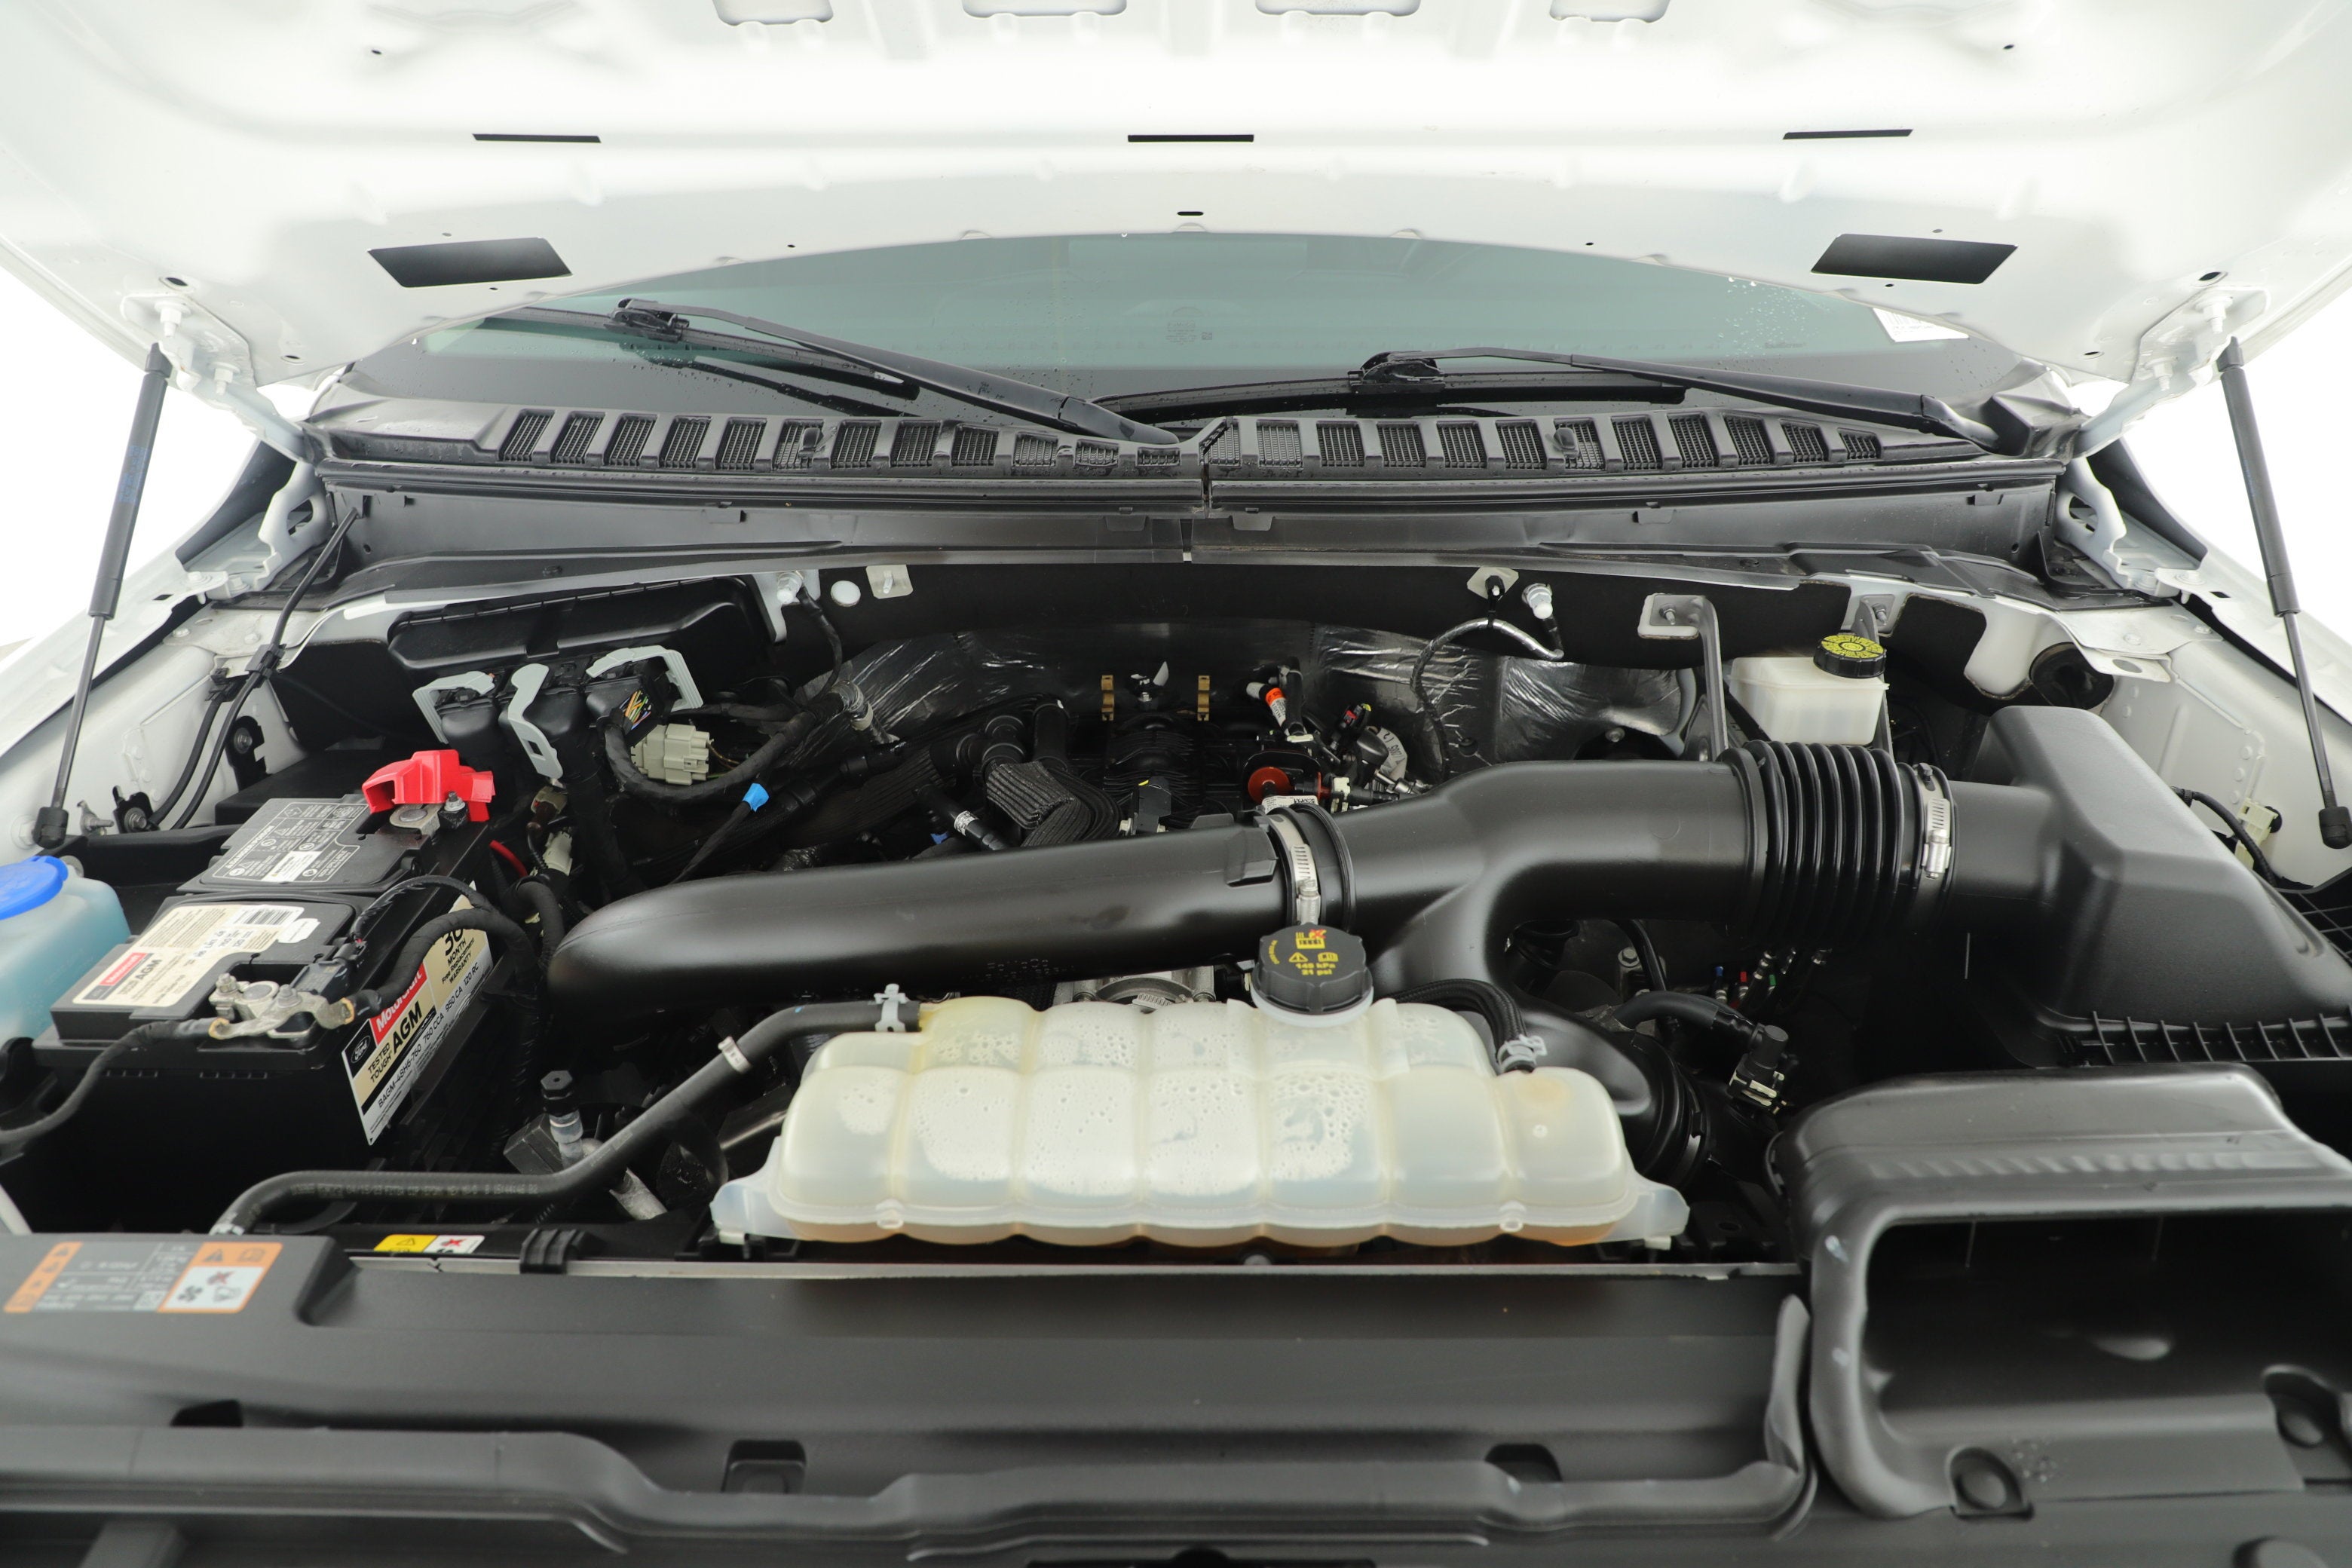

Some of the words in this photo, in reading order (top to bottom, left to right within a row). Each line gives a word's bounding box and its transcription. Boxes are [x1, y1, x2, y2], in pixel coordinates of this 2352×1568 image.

[442, 971, 451, 984] Free
[450, 937, 475, 972] Replacement
[447, 937, 466, 965] MONTH
[449, 951, 471, 984] WARRANTY
[136, 960, 162, 980] AGM
[423, 1027, 433, 1043] 760
[433, 1012, 444, 1030] CCA
[446, 996, 455, 1012] 950
[455, 986, 463, 999] CA
[472, 961, 479, 975] RC
[394, 1000, 422, 1055] AGM
[368, 1043, 390, 1073] TESTED
